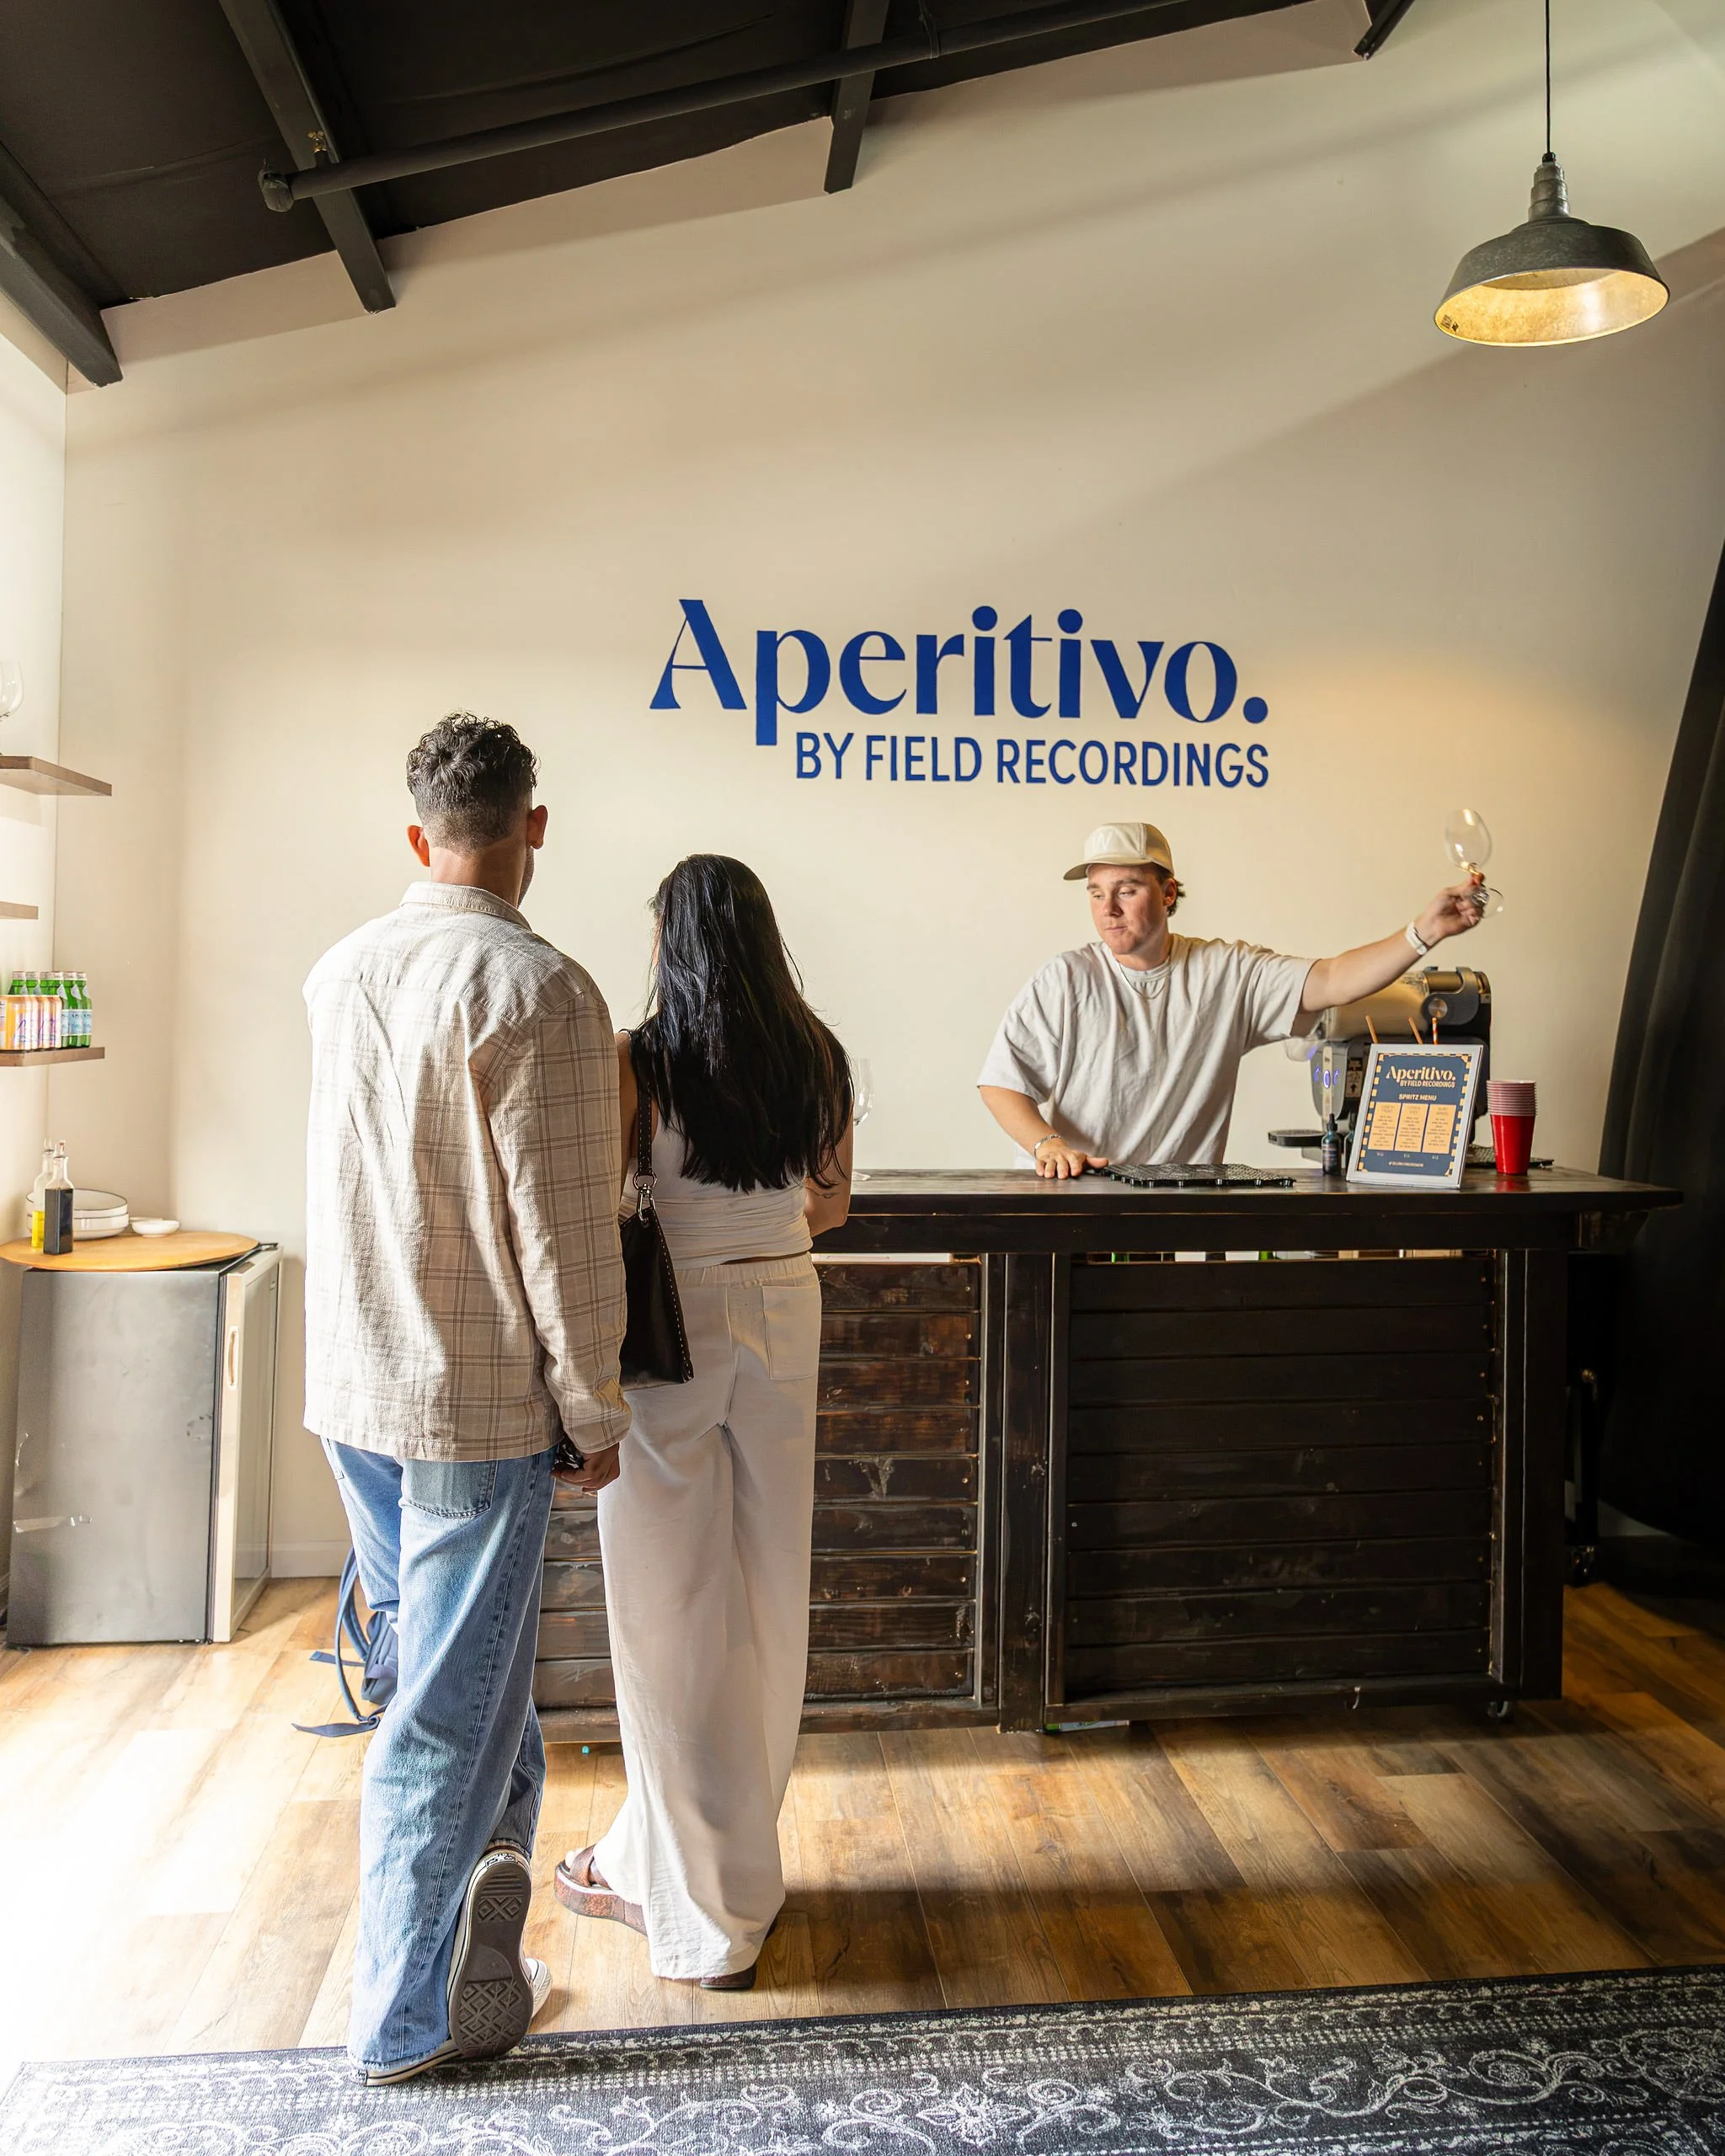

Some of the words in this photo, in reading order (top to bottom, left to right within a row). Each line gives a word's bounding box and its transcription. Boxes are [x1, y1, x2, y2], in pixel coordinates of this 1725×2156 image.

[650, 600, 1268, 746] Aperitivo.
[797, 732, 854, 779] BY
[865, 735, 982, 782] FIELD
[997, 739, 1268, 788] RECORDINGS
[1386, 1065, 1456, 1083] Aperitivo.
